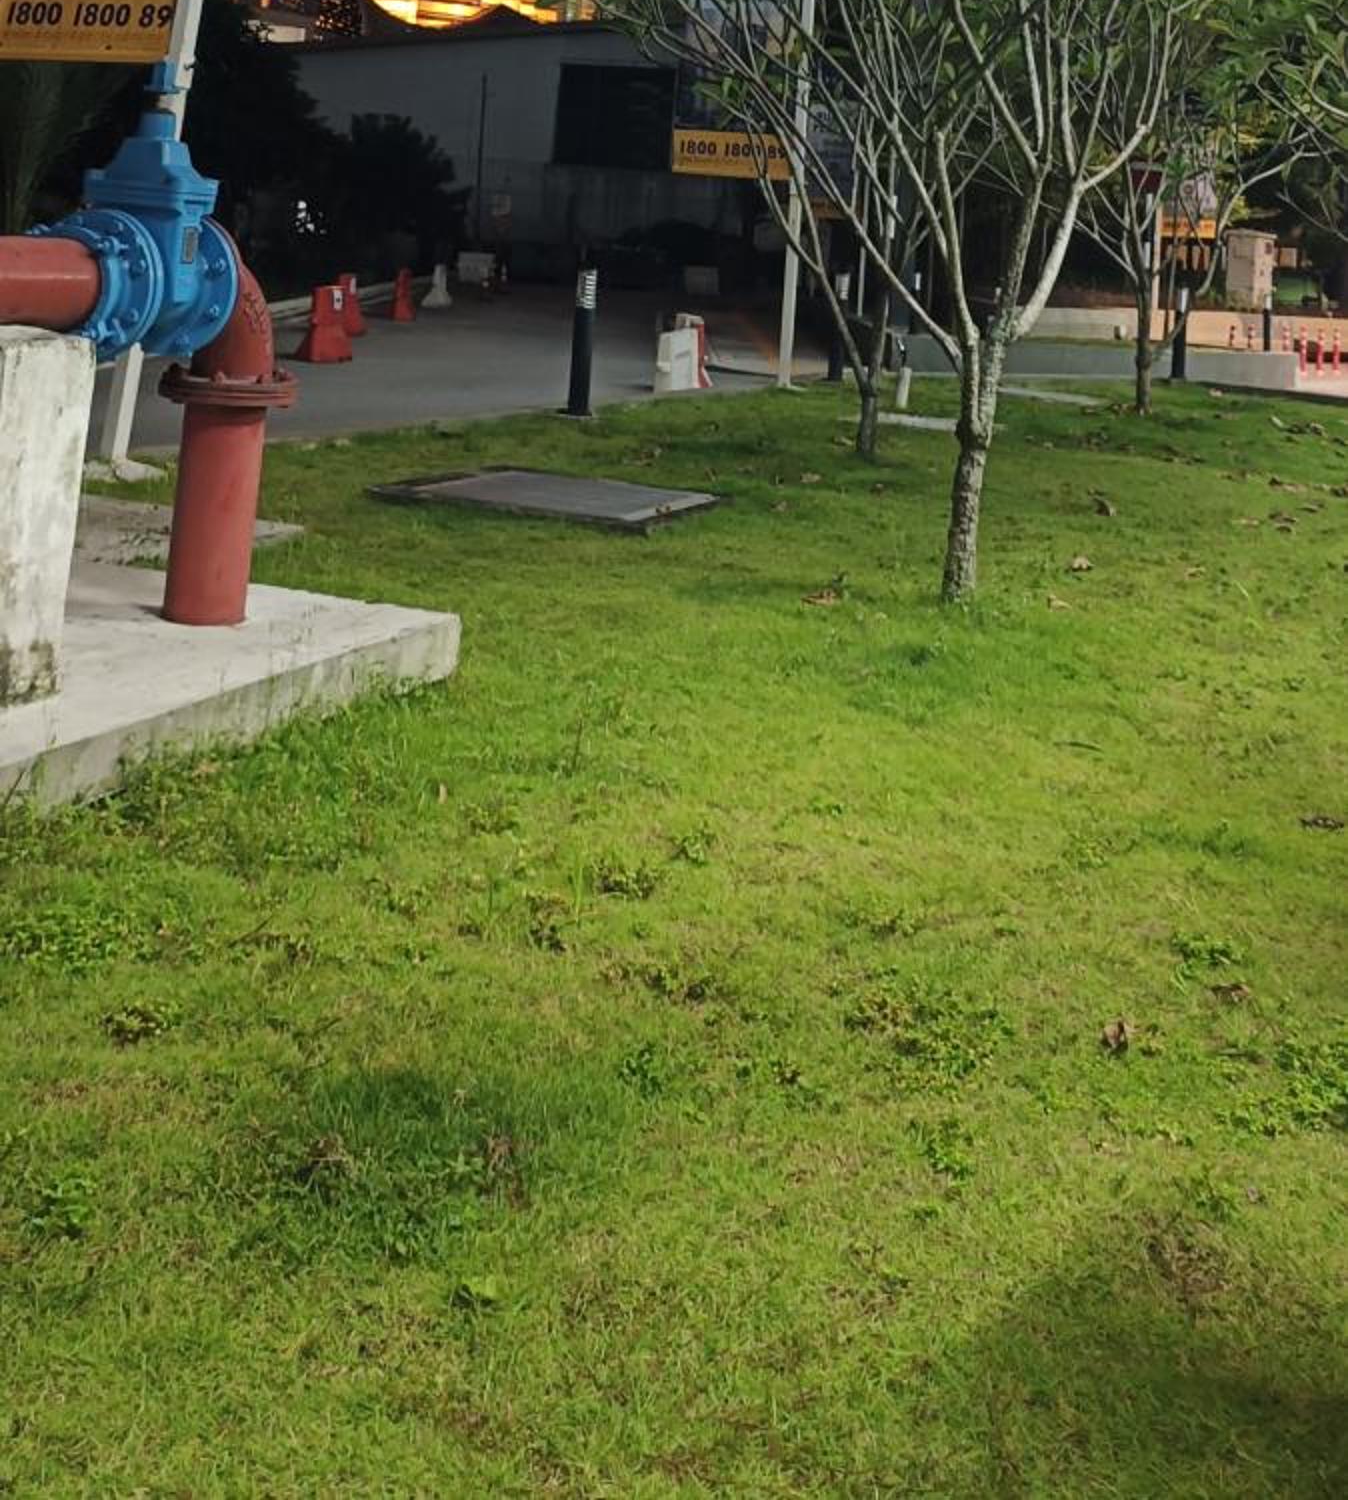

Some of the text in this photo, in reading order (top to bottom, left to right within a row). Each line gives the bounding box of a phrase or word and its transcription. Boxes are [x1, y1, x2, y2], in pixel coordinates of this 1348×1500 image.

[7, 1, 63, 26] 1800
[73, 3, 131, 27] 1800
[680, 139, 717, 155] 1800
